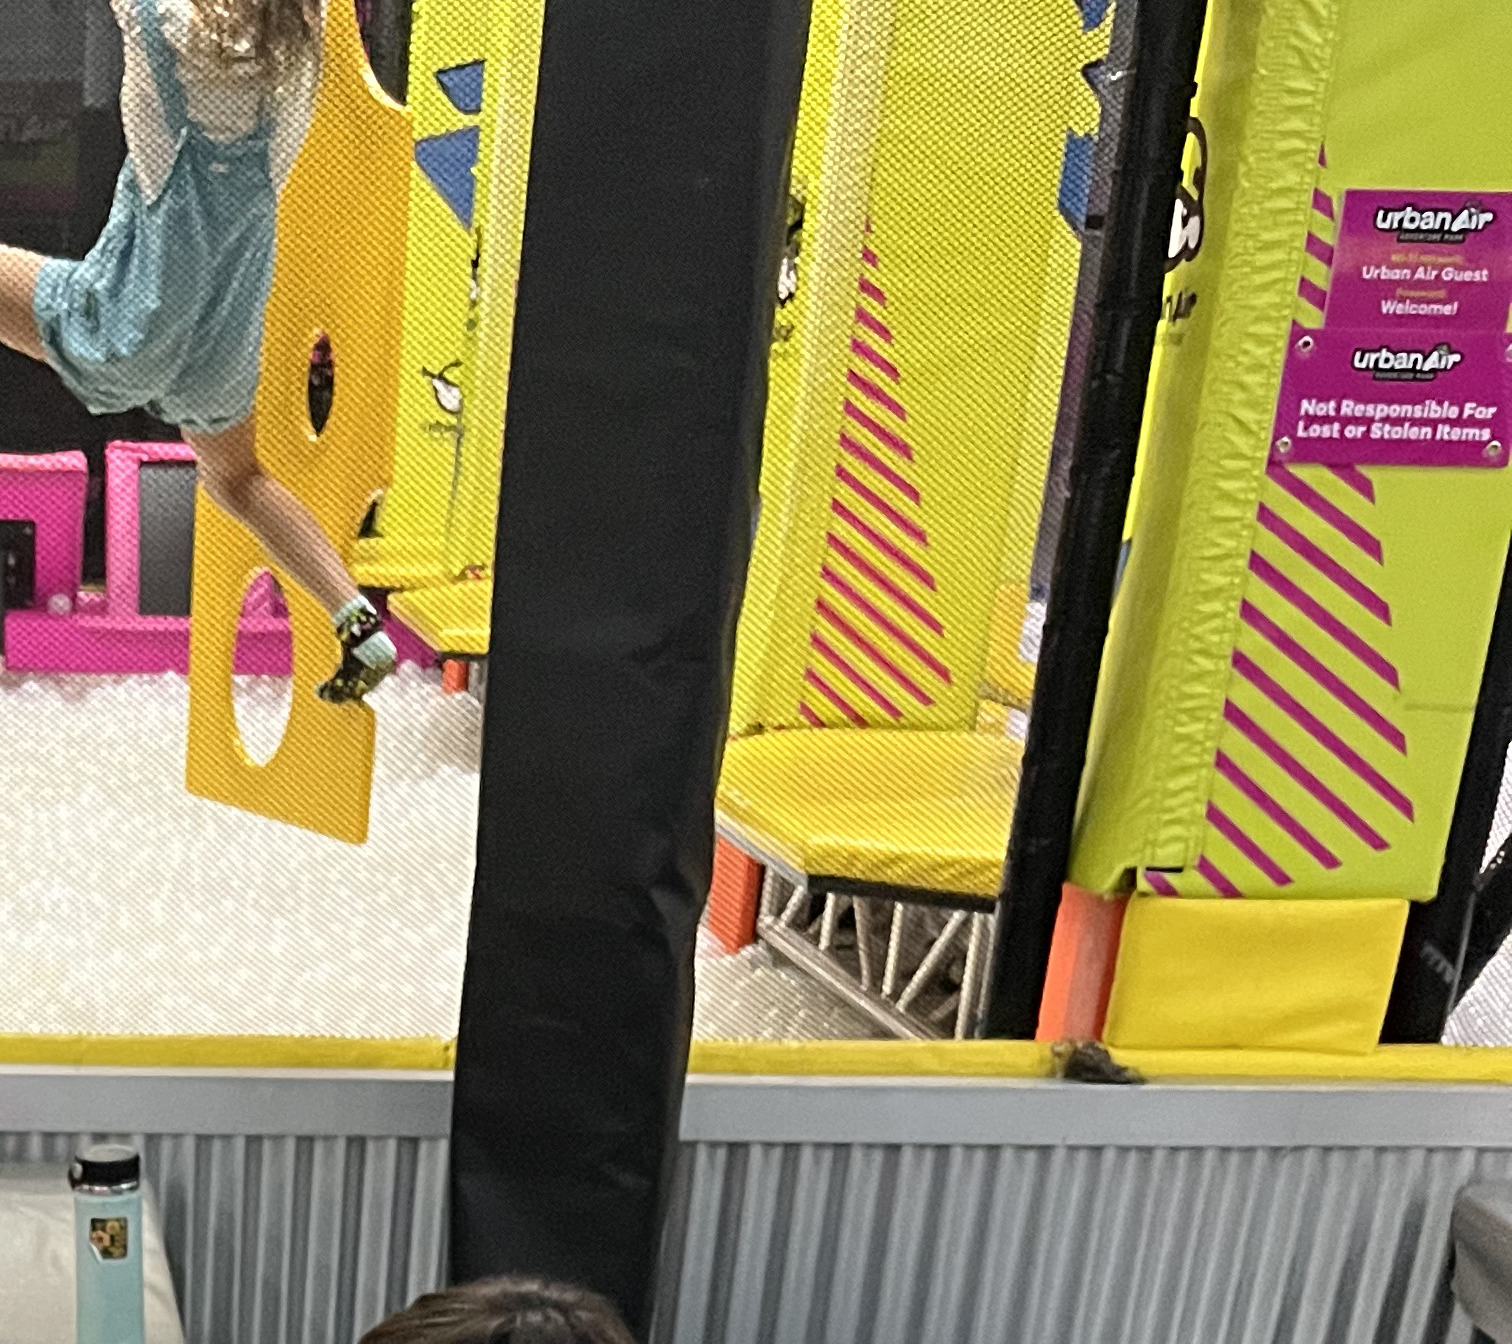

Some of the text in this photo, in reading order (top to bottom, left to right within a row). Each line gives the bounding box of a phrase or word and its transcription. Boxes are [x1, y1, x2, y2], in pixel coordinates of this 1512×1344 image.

[1362, 265, 1488, 281] Urban Air Guest
[1381, 299, 1458, 315] Welcome!
[1299, 399, 1497, 420] Not Responsible For
[1297, 421, 1491, 441] Lost or Stolen Items
